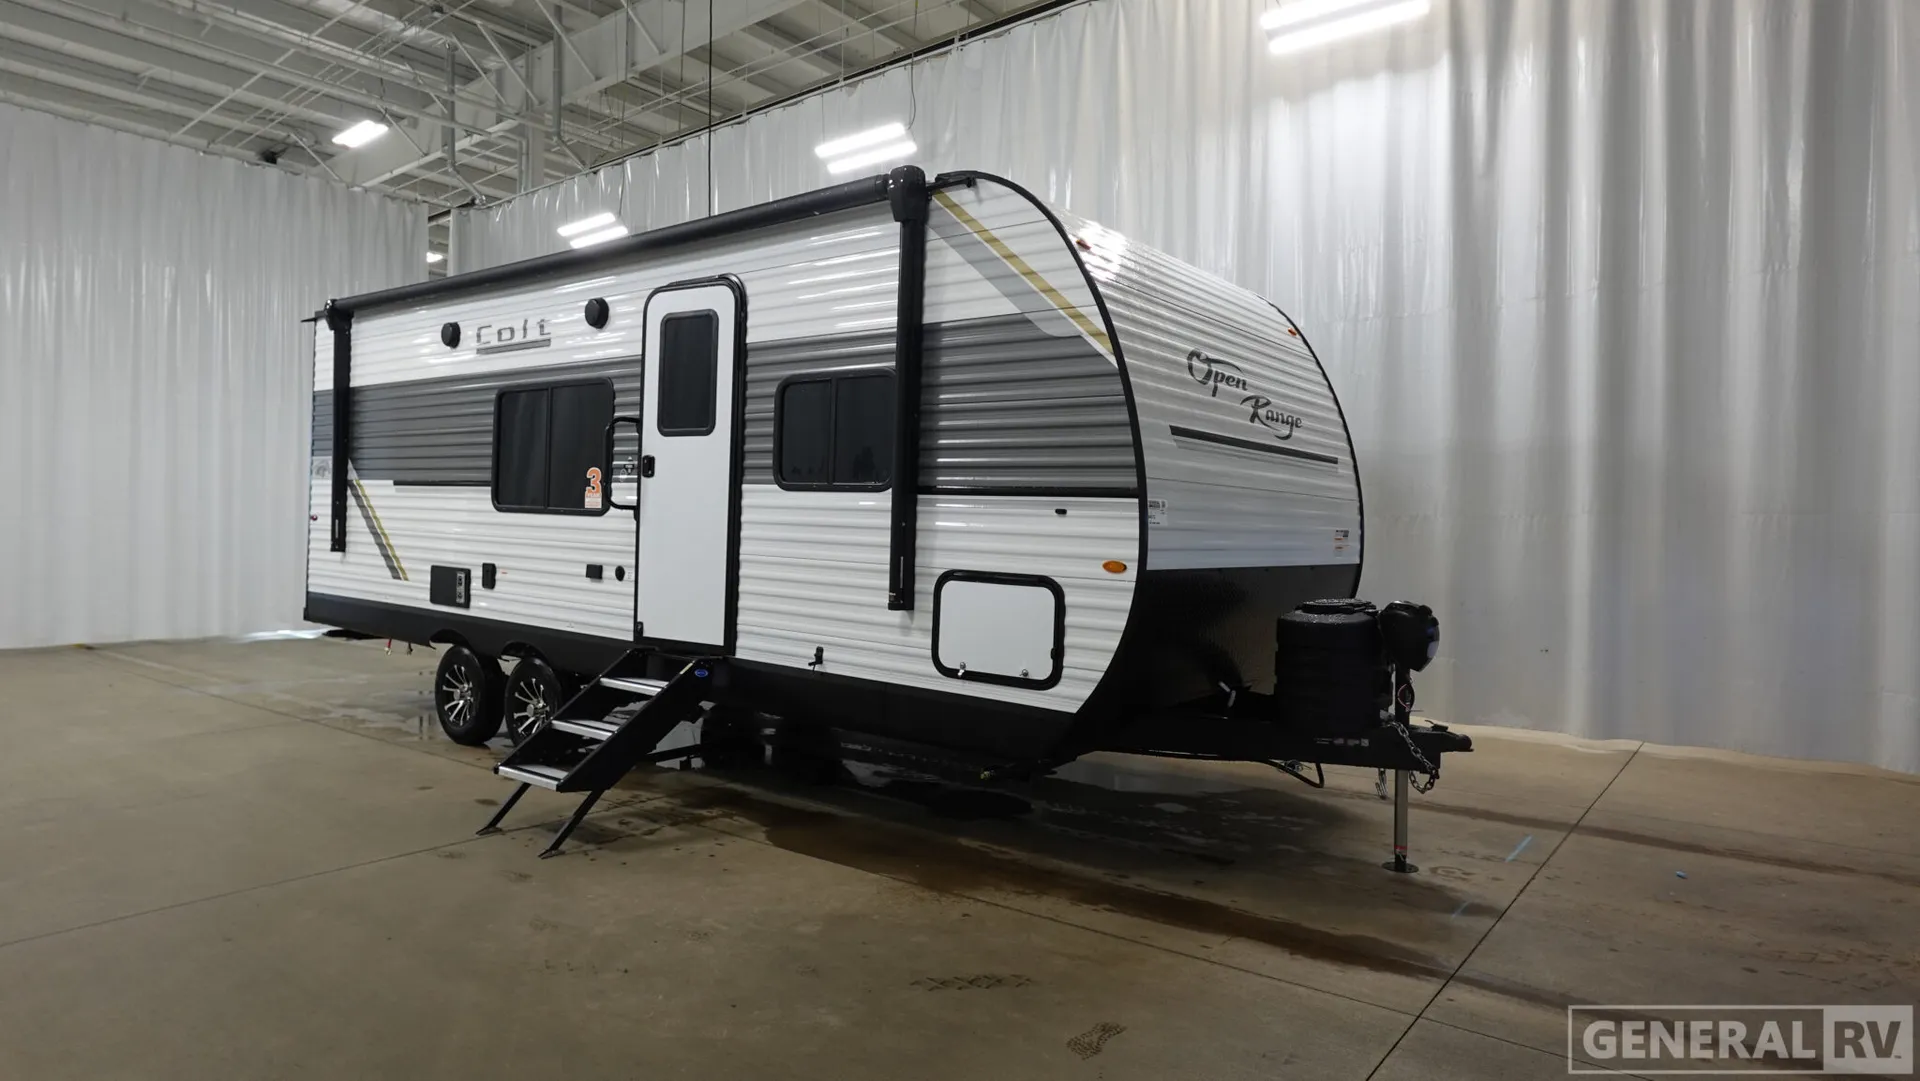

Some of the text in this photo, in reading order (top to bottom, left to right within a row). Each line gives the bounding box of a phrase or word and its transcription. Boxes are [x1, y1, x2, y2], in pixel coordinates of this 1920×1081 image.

[476, 318, 551, 345] Colt
[1186, 349, 1248, 397] Open
[1240, 395, 1303, 440] Range
[586, 467, 602, 494] 3
